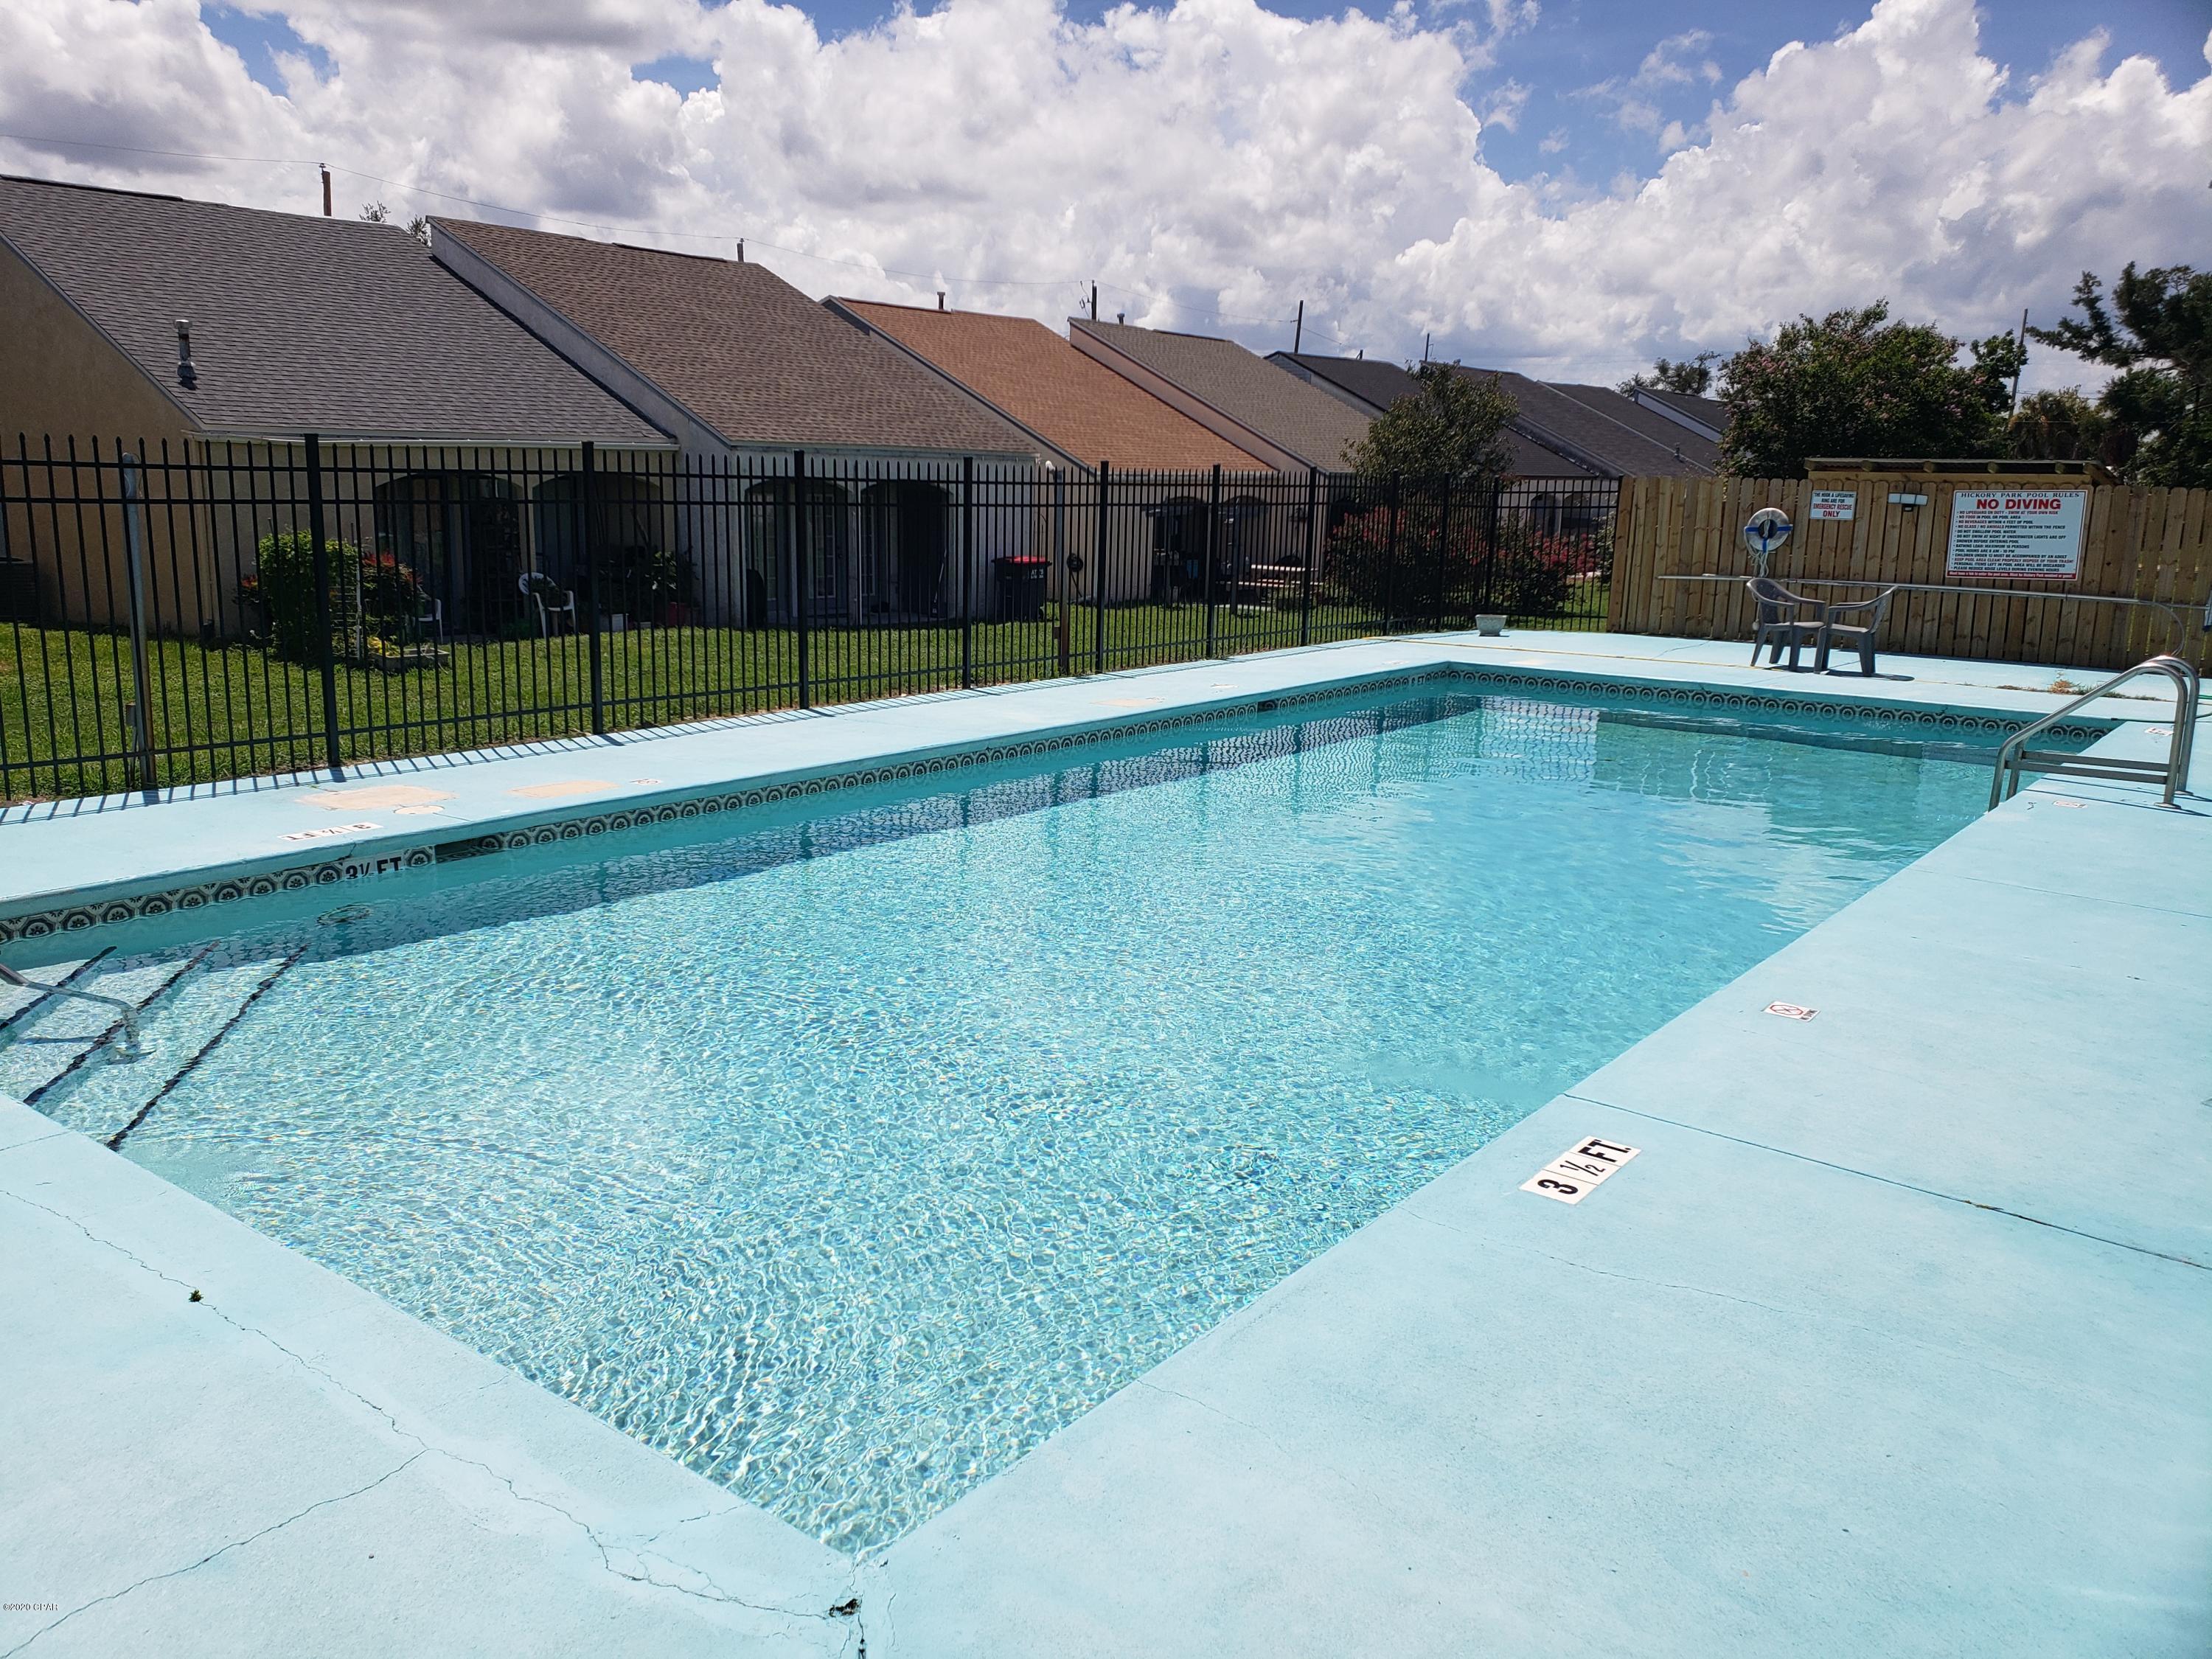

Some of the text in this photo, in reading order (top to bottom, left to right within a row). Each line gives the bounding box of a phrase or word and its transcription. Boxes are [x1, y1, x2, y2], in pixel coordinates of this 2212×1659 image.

[1976, 499, 2061, 509] NO DIVING
[1537, 1179, 1578, 1194] 3
